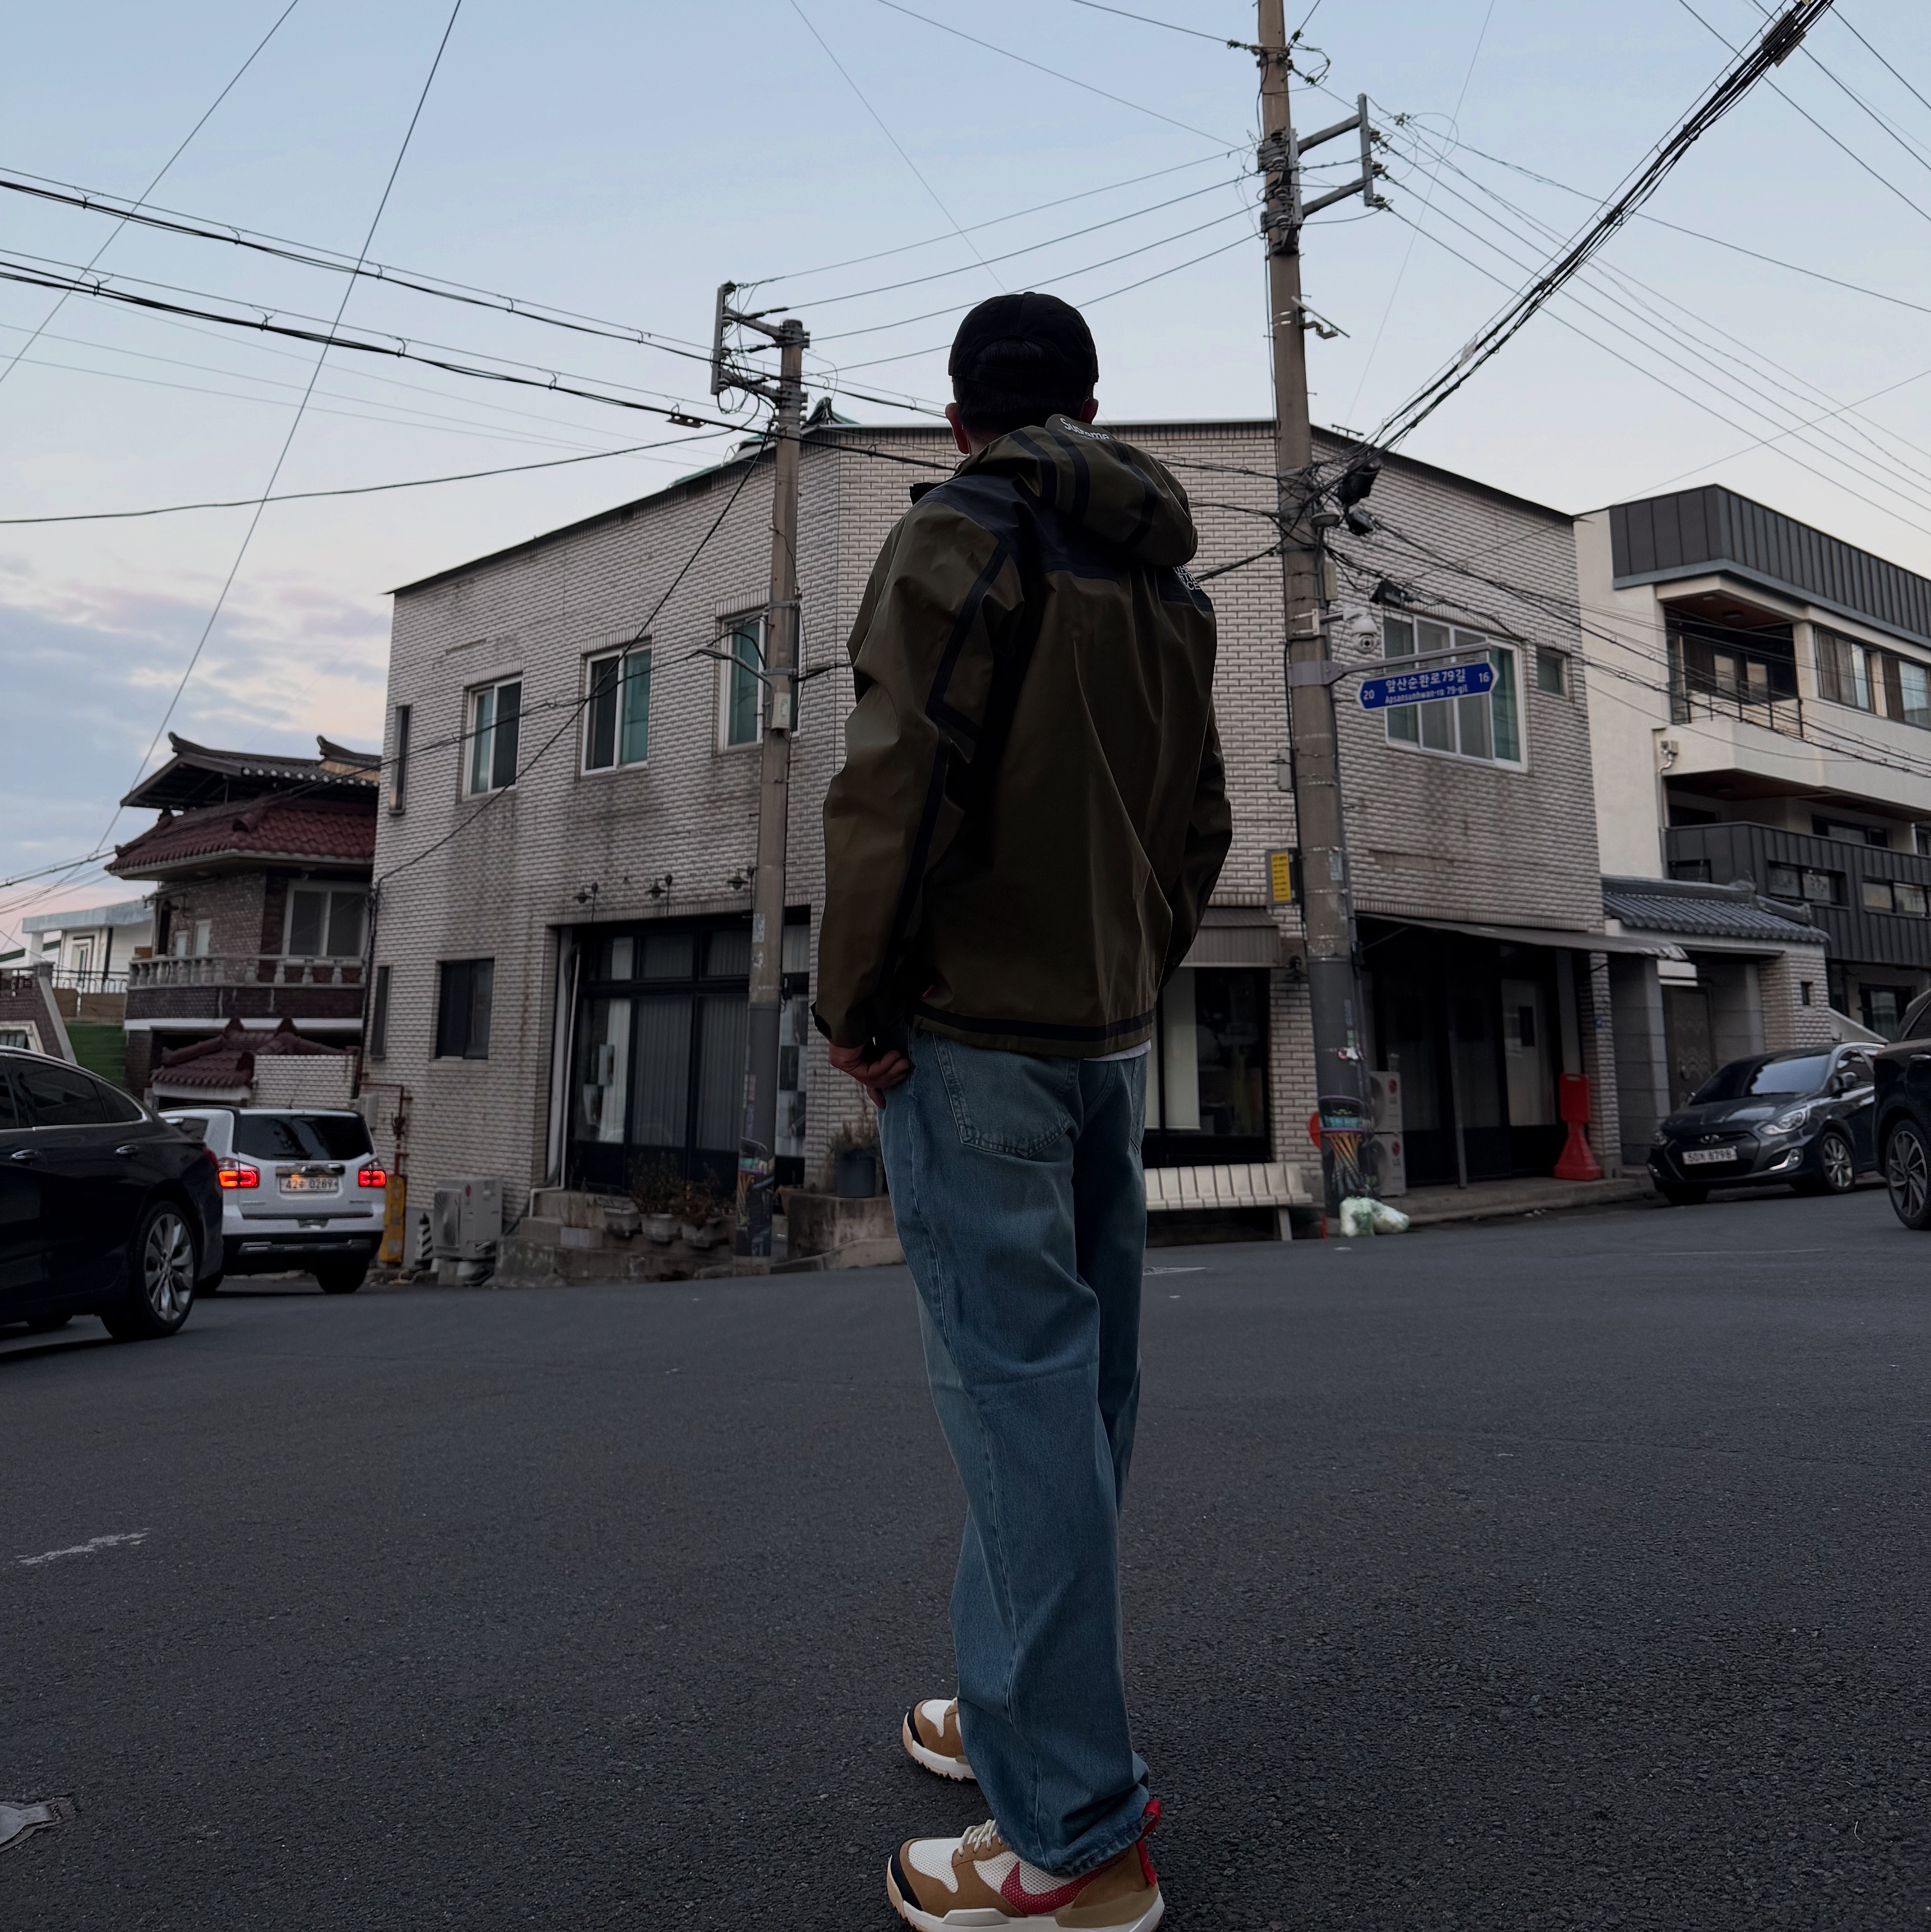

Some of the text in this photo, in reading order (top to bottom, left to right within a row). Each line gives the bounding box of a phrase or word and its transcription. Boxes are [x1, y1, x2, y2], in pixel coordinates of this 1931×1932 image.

[1060, 418, 1110, 440] Supreme
[1385, 668, 1466, 694] 앞산순환로79길
[1478, 672, 1490, 683] 16
[1363, 689, 1375, 701] 20
[1446, 684, 1468, 696] 79-gil
